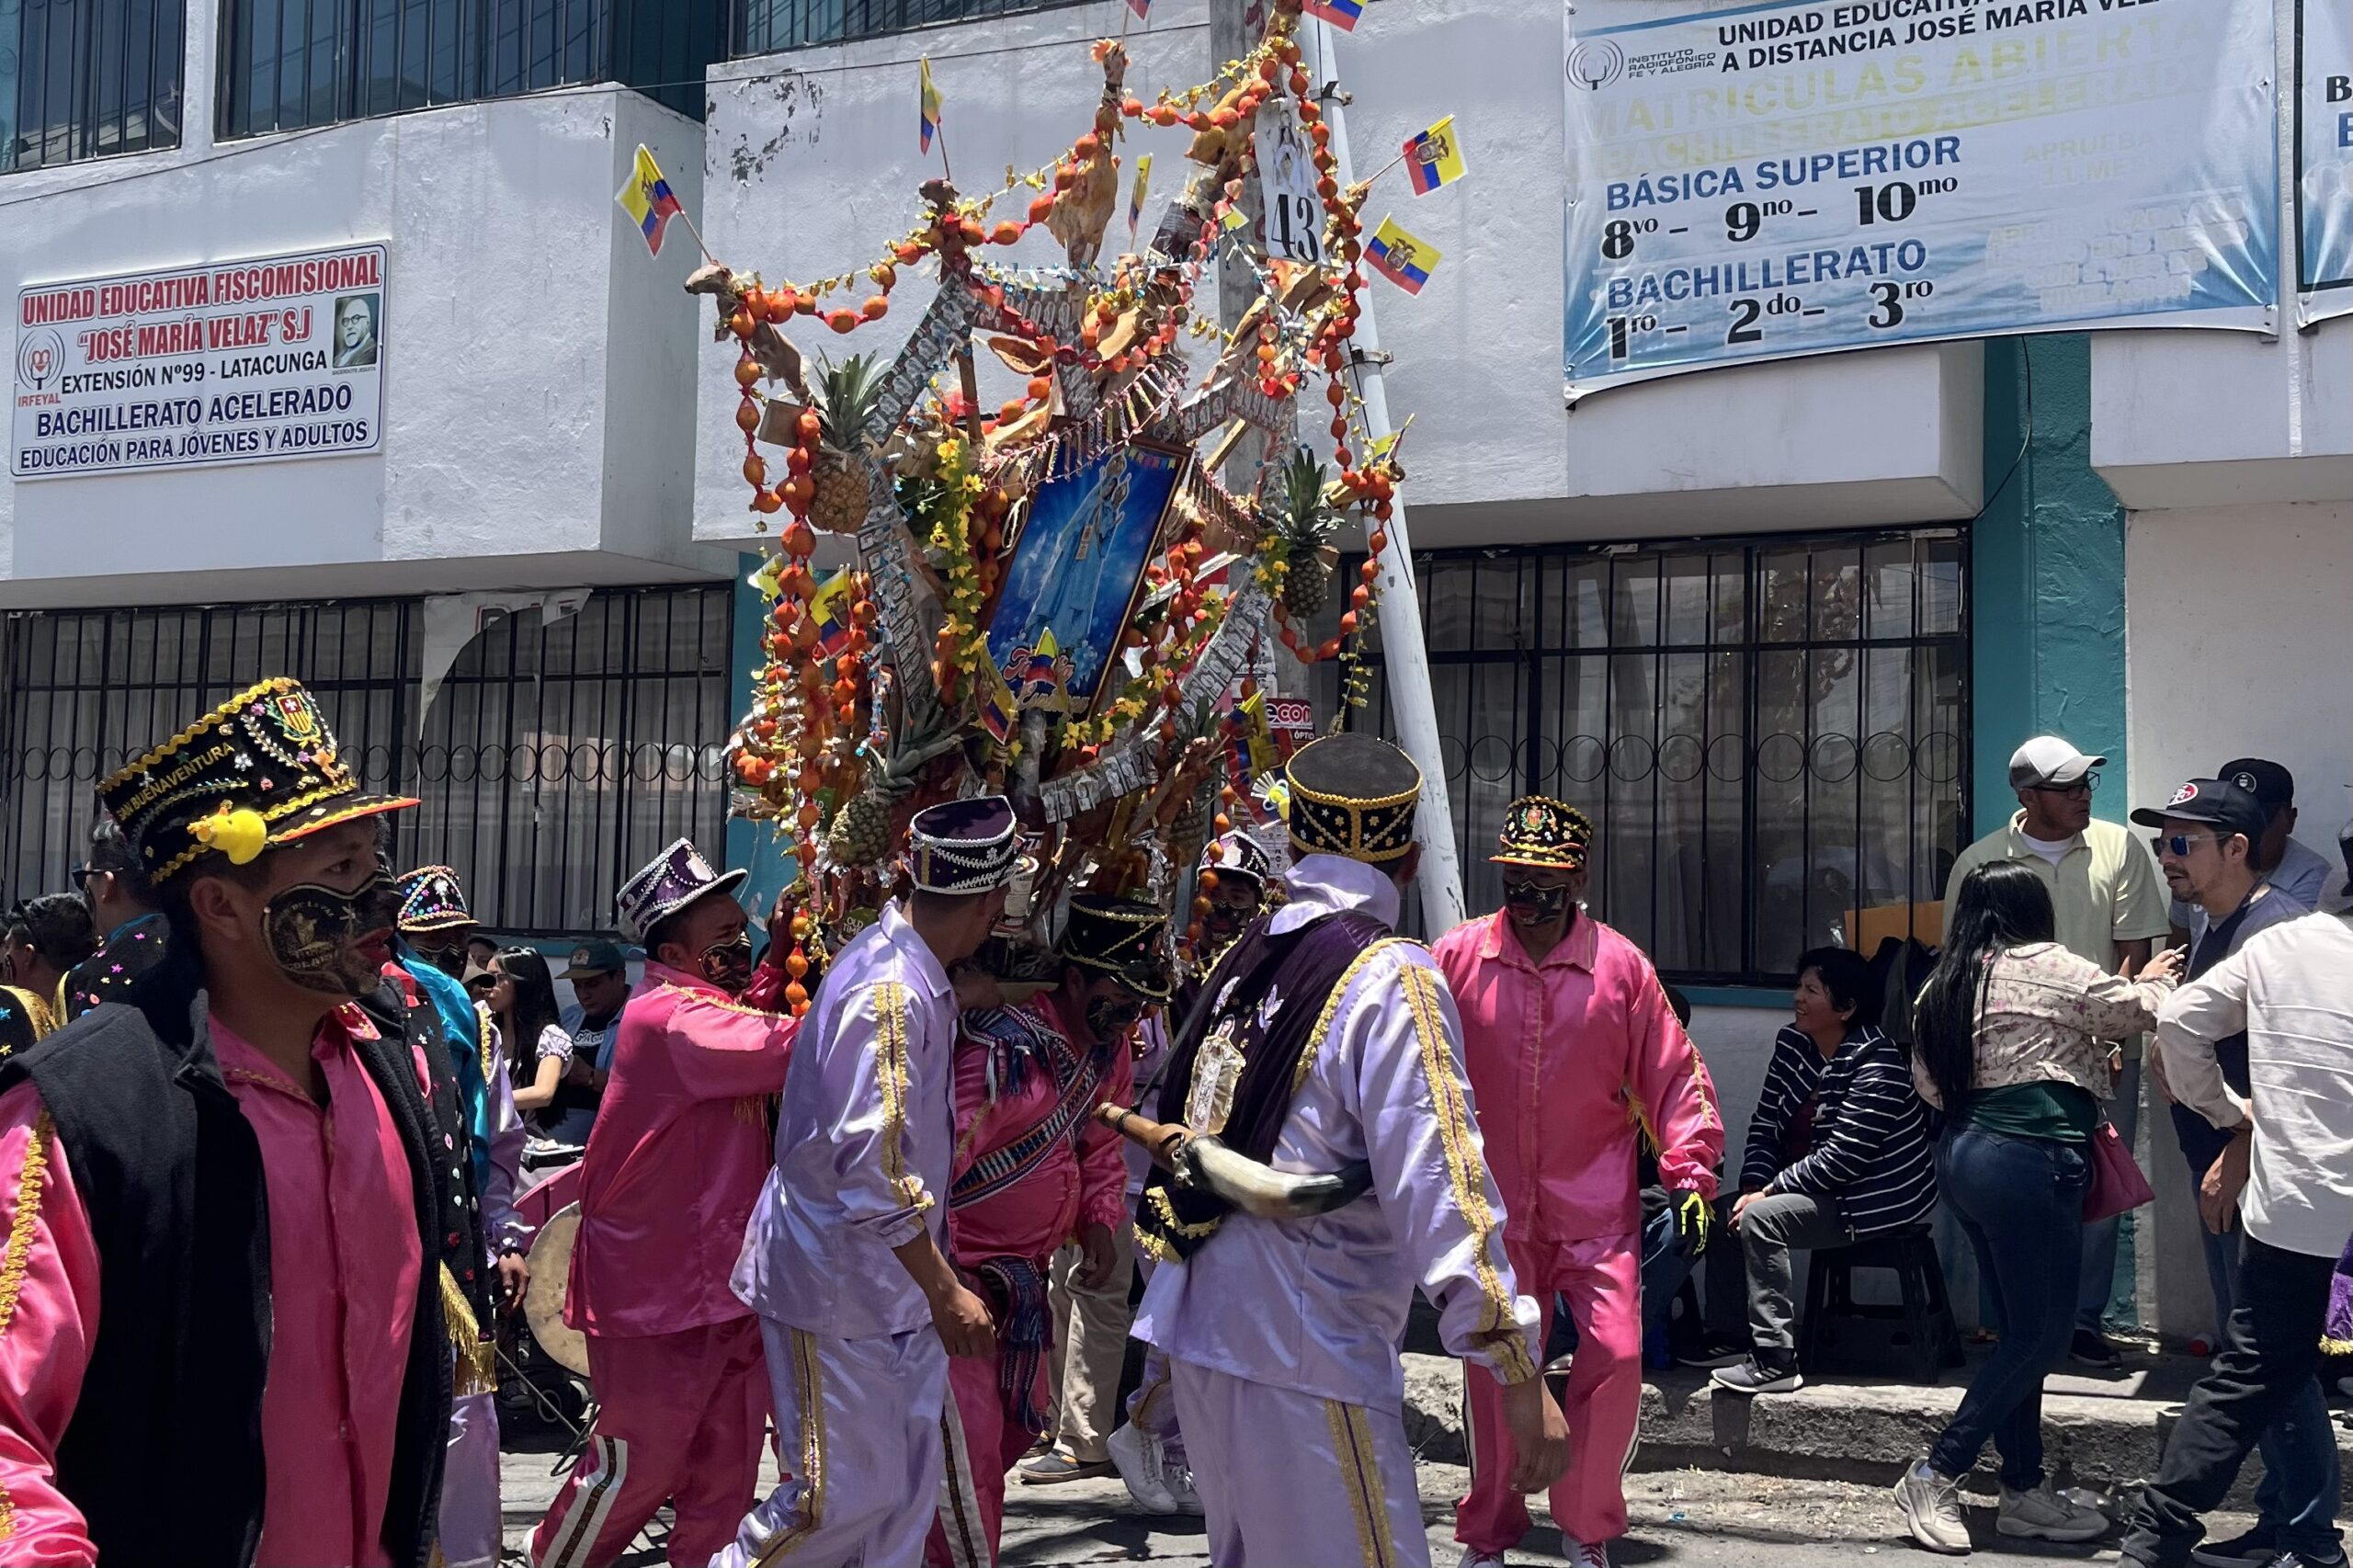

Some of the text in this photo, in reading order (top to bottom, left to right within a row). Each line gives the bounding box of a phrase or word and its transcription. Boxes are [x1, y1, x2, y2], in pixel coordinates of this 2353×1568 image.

[1718, 0, 1995, 46] UNIDAD EDUCATI
[1722, 52, 1739, 73] A
[1749, 27, 1897, 68] DISTANCIA
[1904, 8, 1975, 44] JOSÉ
[1628, 49, 1693, 63] INSTITUTO
[1628, 52, 1716, 72] RADIOFÓNICO
[1629, 71, 1645, 79] FE
[1661, 60, 1715, 74] ALEGRÍA
[1608, 136, 1961, 210] BÁSICA SUPERIOR
[1854, 176, 1958, 226] 10mo
[1271, 194, 1319, 263] 43
[23, 255, 380, 324] UNIDAD EDUCATIVA FISCOMISIONAL
[1608, 239, 1926, 310] BACHILLERATO
[138, 313, 202, 357] MARÍA
[62, 367, 155, 394] EXTENSIÓN
[222, 350, 327, 379] LATACUNGA
[18, 393, 61, 407] IRFEYAL
[38, 384, 352, 437] BACHILLERATO ACELERADO
[21, 421, 368, 469] EDUCACIÓN PARA JÓVENES Y ADULTOS
[132, 742, 235, 810] BUENAVENTURA
[843, 924, 861, 936] TIME
[847, 917, 864, 928] OLD
